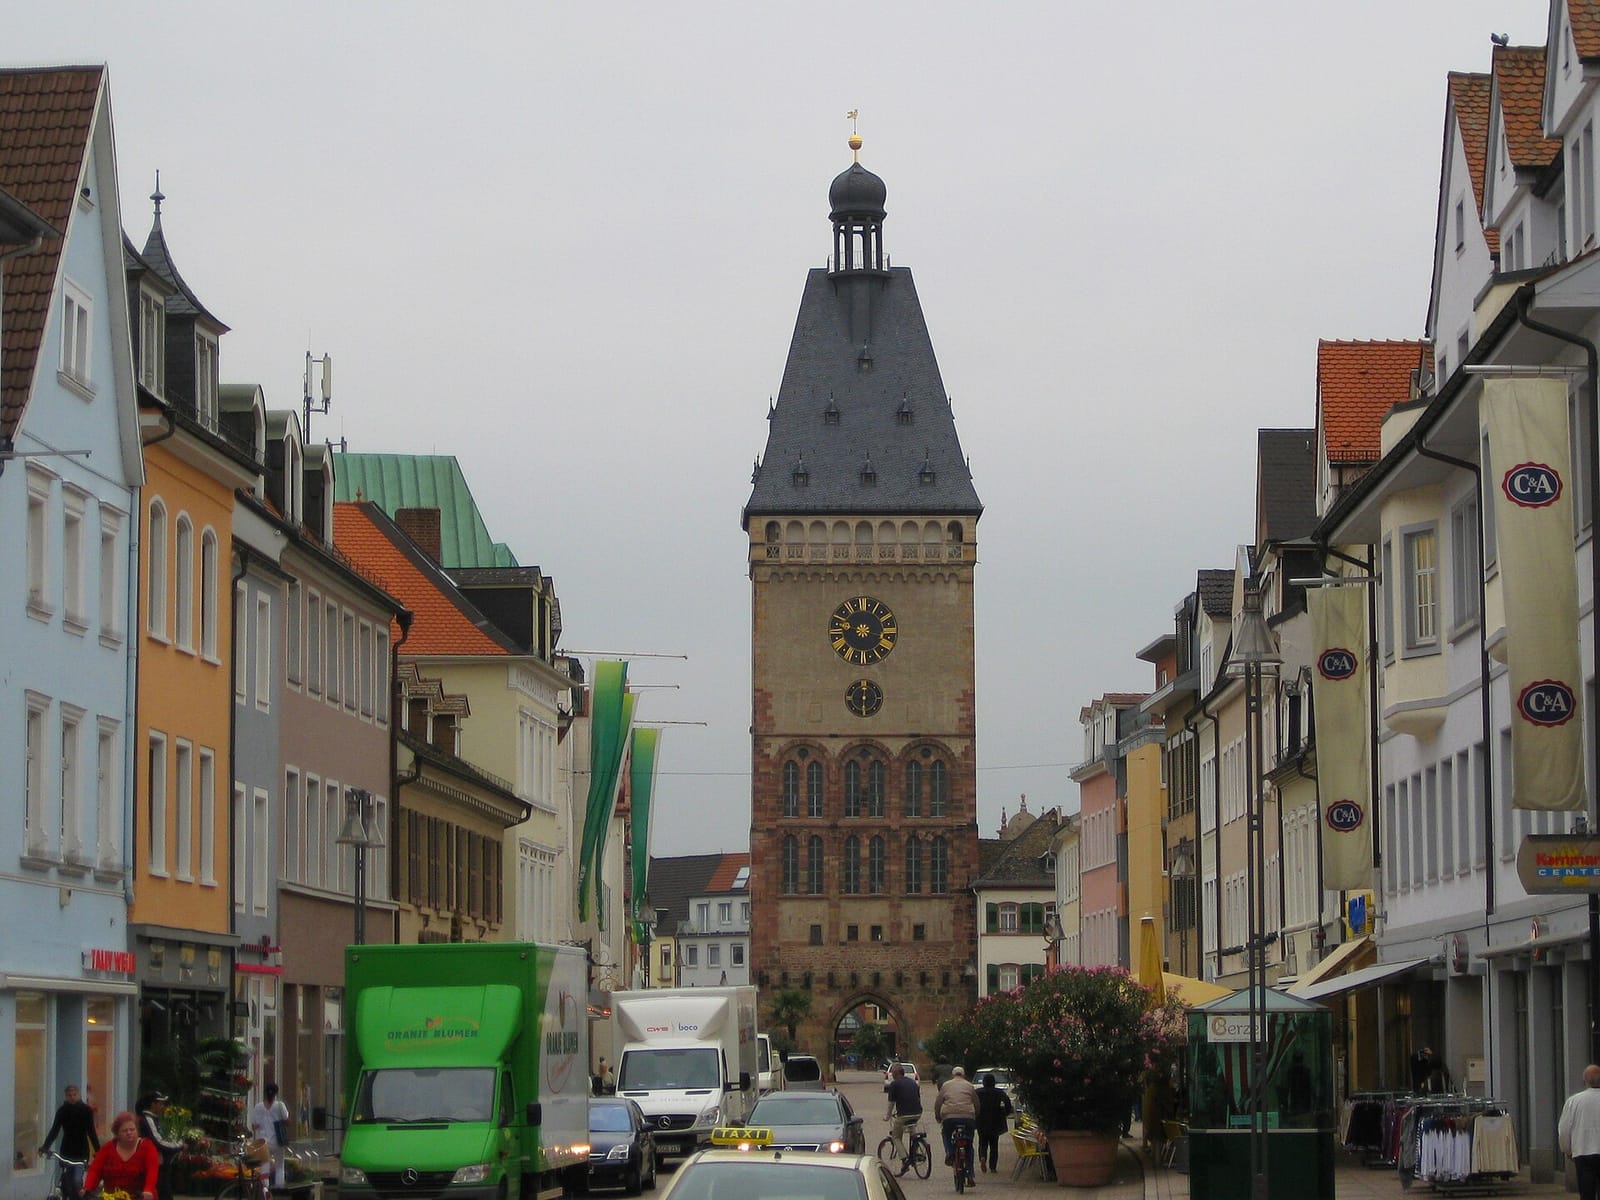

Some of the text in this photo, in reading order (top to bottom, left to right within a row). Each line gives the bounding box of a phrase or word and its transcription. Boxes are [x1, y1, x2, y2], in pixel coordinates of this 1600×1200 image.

[1514, 474, 1554, 494] C&A
[1324, 655, 1351, 671] C&A
[1529, 691, 1568, 712] C&A
[1333, 808, 1357, 823] C&A
[433, 1028, 479, 1039] BLUMEN
[678, 1021, 698, 1031] boco
[720, 1128, 761, 1138] TAXI
